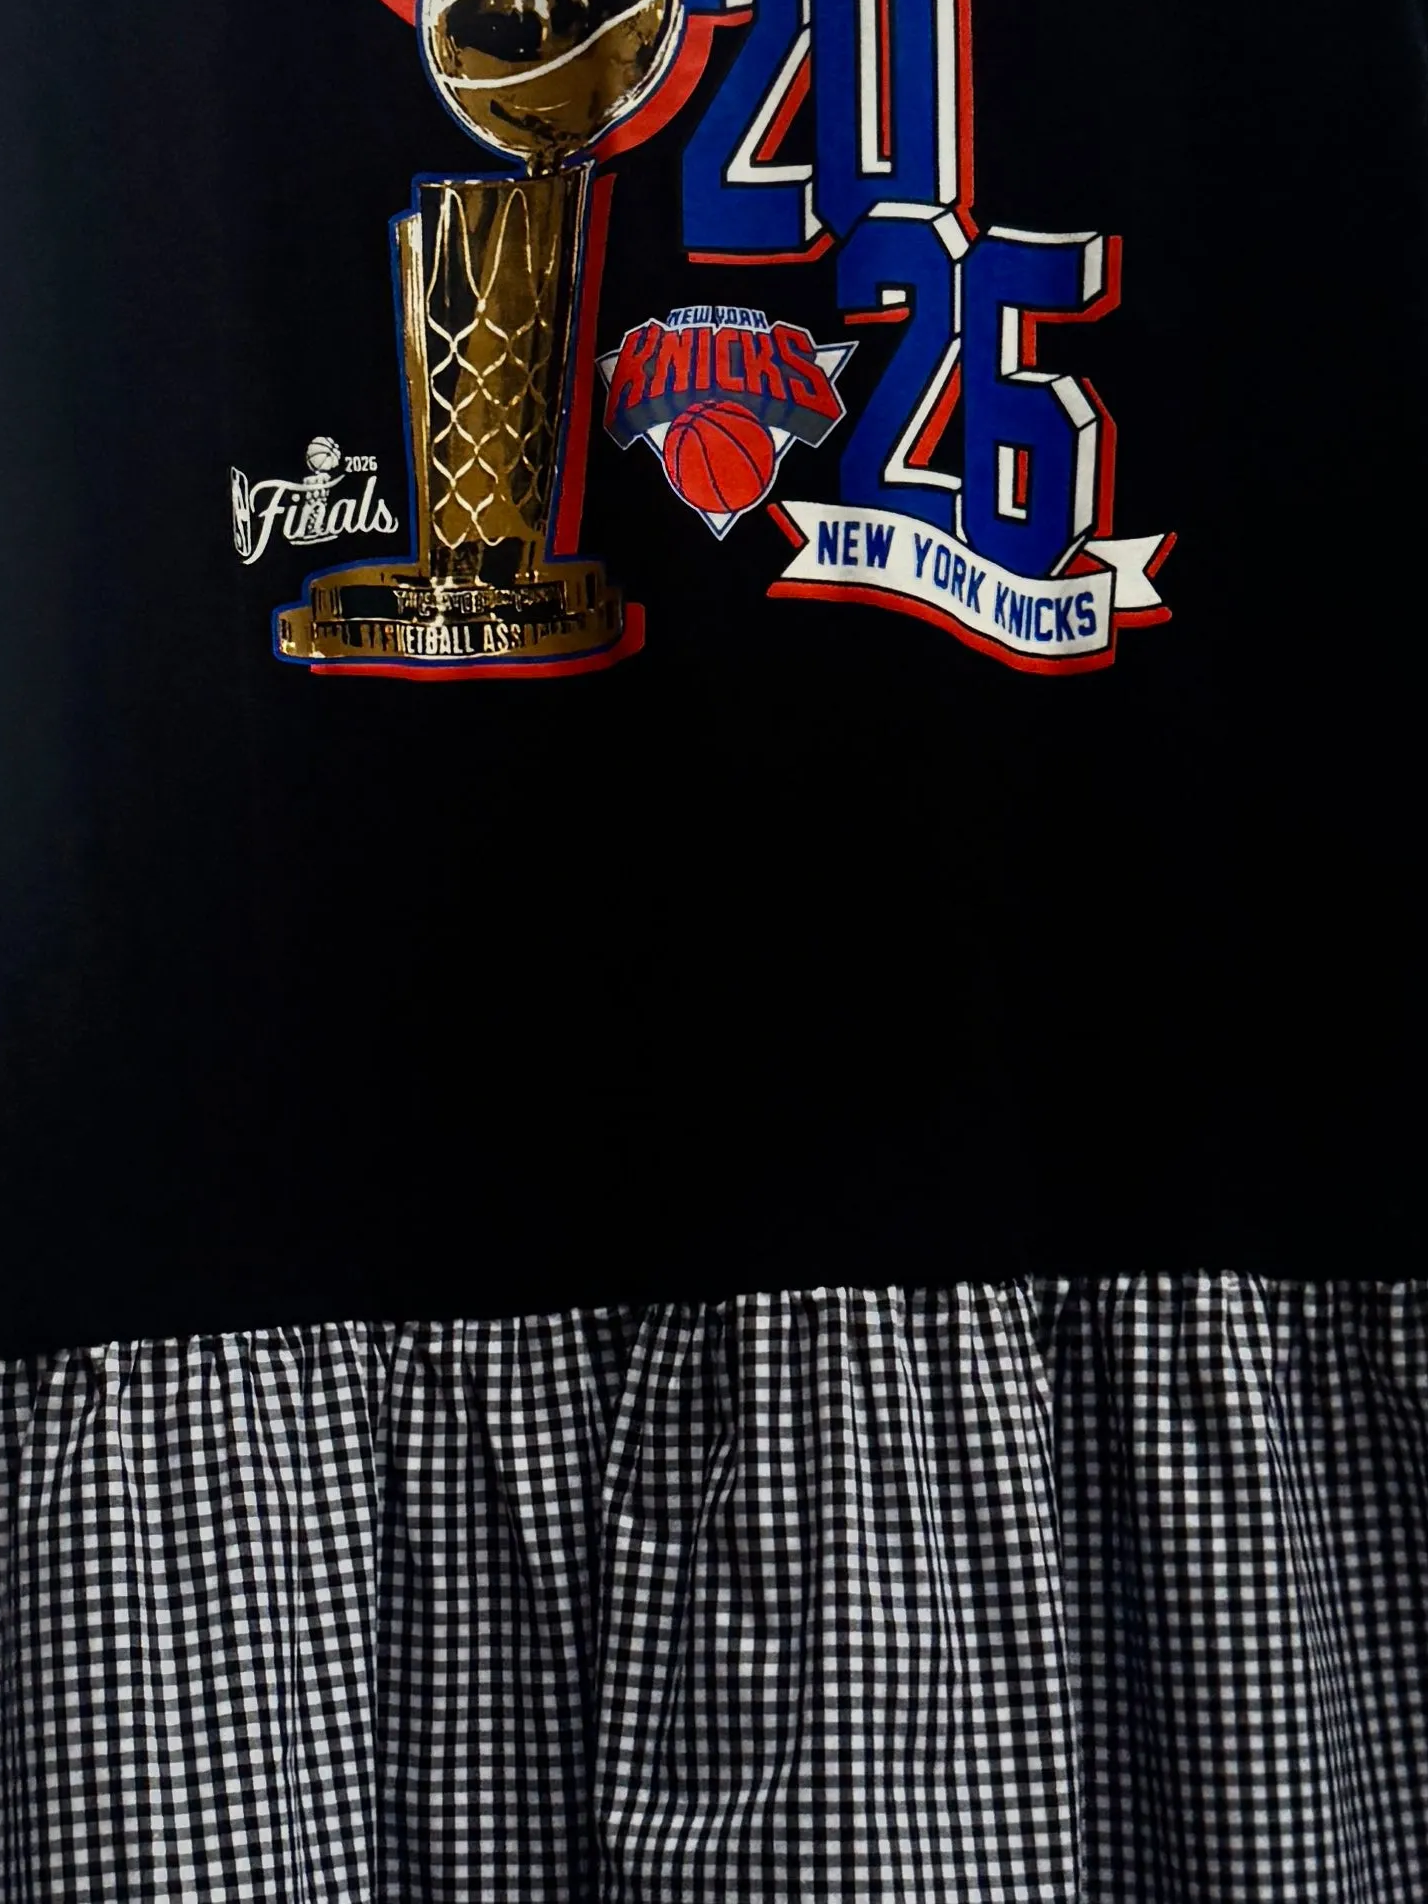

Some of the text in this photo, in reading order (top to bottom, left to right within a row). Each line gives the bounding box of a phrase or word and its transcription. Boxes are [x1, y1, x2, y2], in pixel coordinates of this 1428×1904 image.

[668, 307, 769, 330] NEW YORK
[607, 323, 842, 424] KNICKS
[838, 202, 1104, 581] 26
[345, 456, 378, 473] 2026
[243, 475, 399, 565] Finals
[817, 520, 1098, 642] NEW YORK KNICKS
